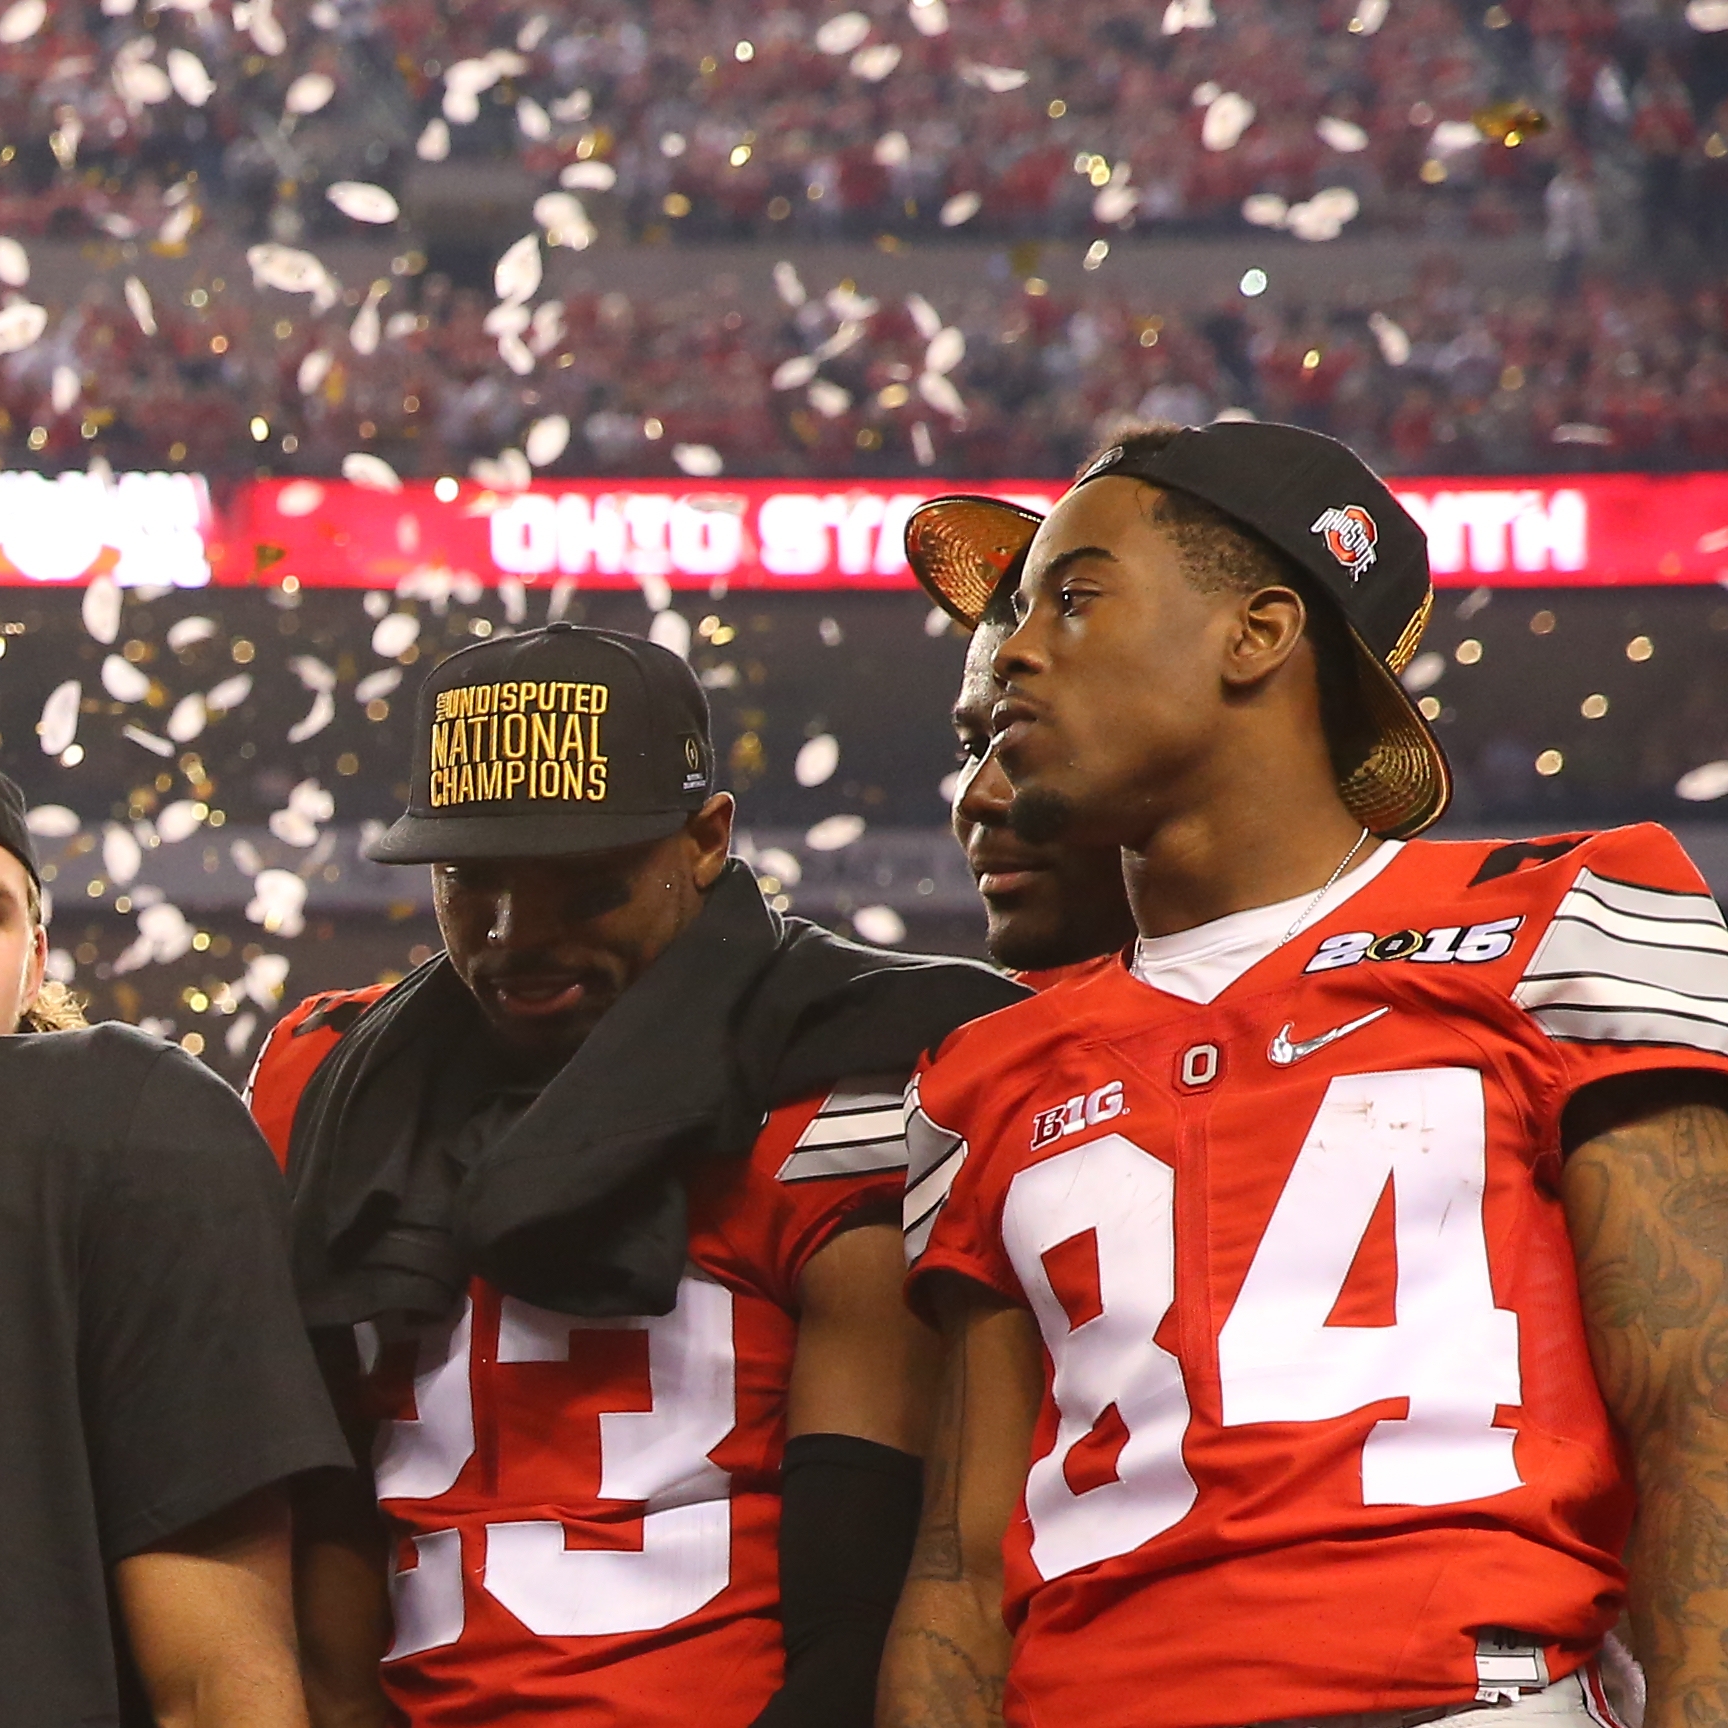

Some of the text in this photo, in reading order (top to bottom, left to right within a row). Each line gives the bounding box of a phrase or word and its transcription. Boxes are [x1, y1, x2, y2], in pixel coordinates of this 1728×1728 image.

[445, 681, 609, 720] UNDISPUTED
[431, 711, 608, 770] NATIONAL
[430, 760, 608, 808] CHAMPIONS
[1002, 1067, 1526, 1582] 84
